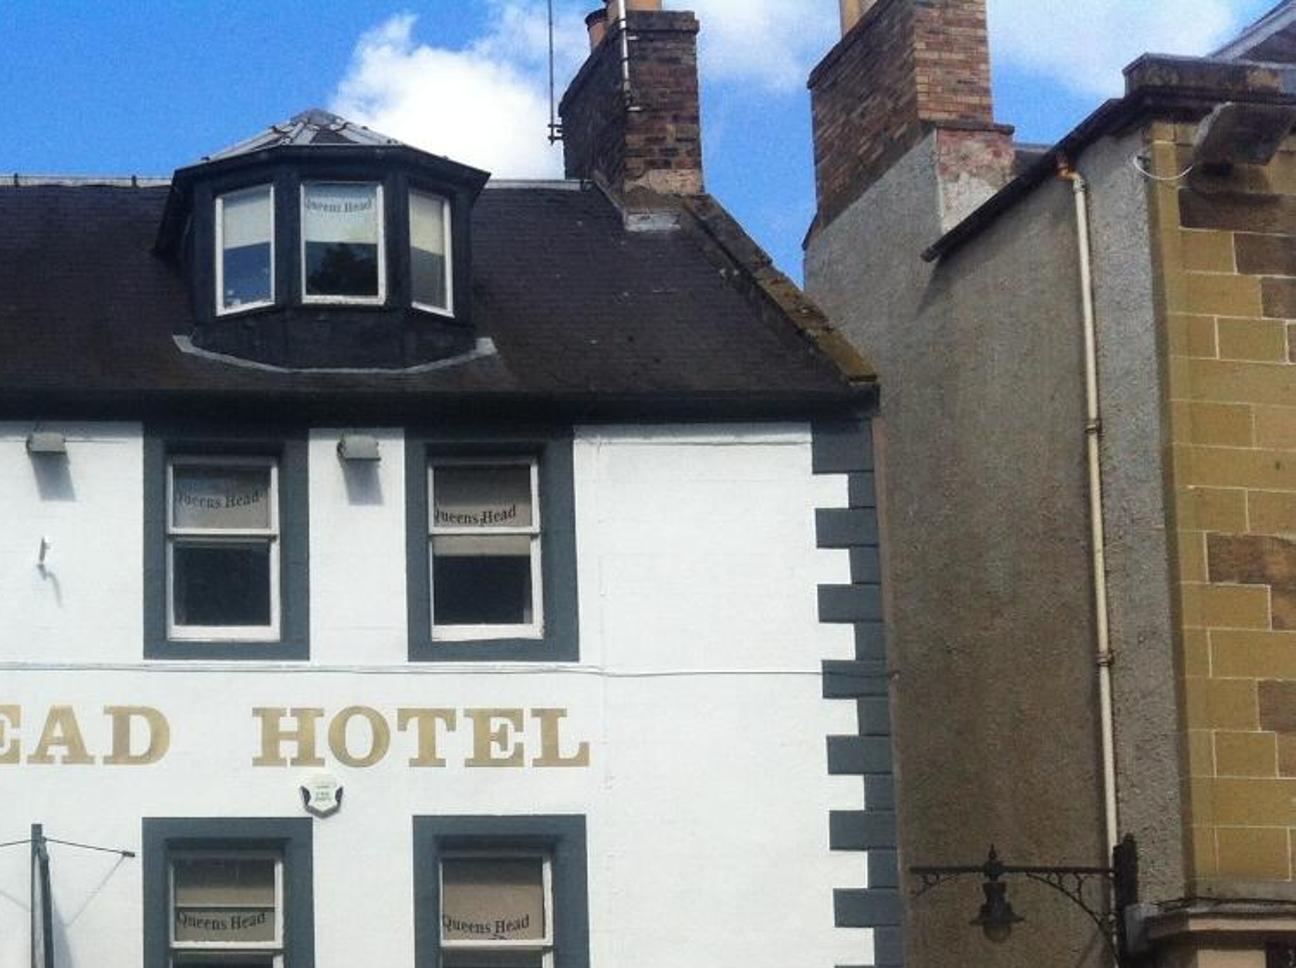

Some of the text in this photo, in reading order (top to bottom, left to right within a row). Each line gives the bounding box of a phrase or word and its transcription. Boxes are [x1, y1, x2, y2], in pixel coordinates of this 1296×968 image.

[225, 489, 260, 508] Head
[481, 504, 516, 525] Head
[252, 706, 591, 768] HOTEL
[176, 911, 266, 930] Queens Head
[442, 914, 530, 933] Queens Head
